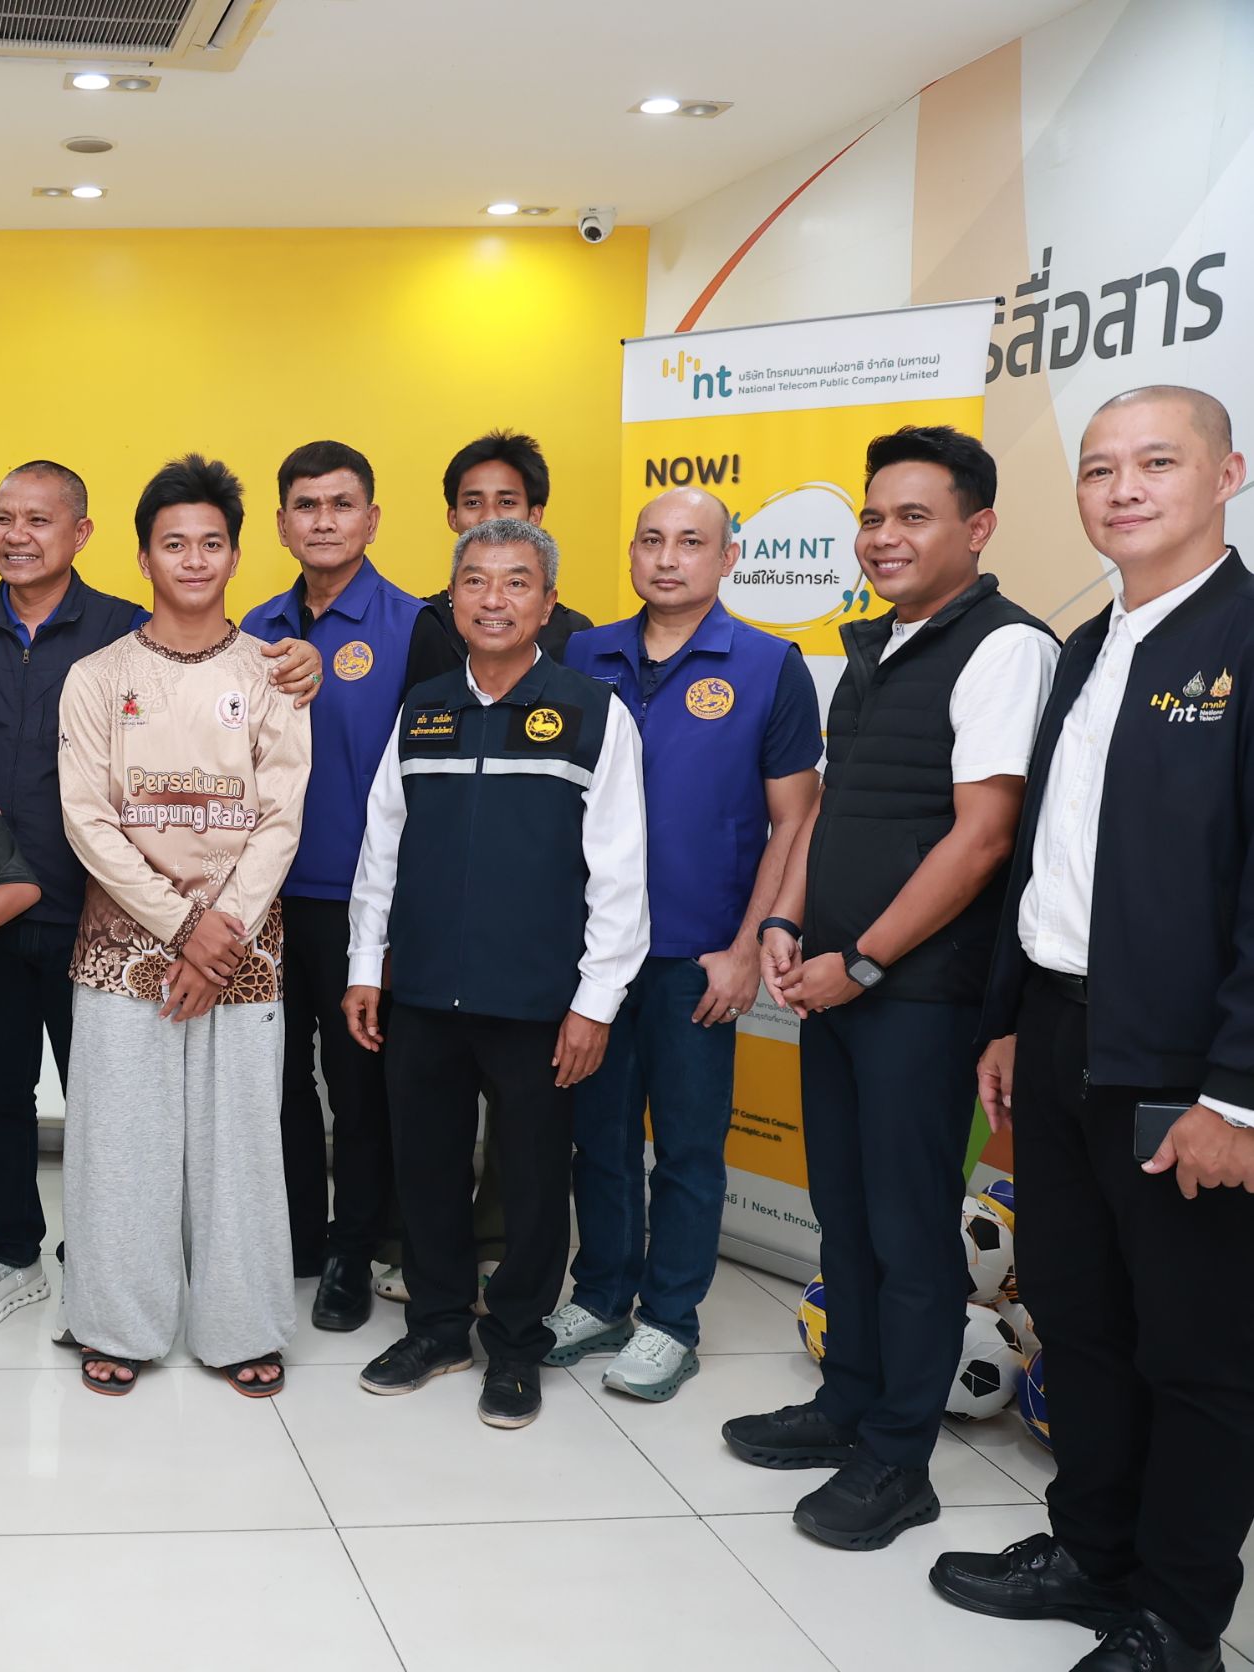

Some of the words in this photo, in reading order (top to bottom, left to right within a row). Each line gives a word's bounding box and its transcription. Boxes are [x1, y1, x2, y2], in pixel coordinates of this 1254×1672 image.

[738, 369, 764, 382] บริษัท
[867, 358, 895, 370] จำกัด
[897, 353, 941, 369] (มหาชน)
[692, 364, 733, 401] nt
[738, 383, 776, 395] National
[778, 381, 818, 392] Telecom
[820, 377, 849, 388] Public
[851, 373, 898, 386] Company
[900, 369, 940, 382] Limited
[645, 453, 741, 488] NOW!
[754, 538, 791, 560] AM
[800, 537, 835, 560] NT
[732, 569, 841, 585] ยินดีให้บริการค่ะ
[1168, 703, 1197, 722] nt
[128, 766, 244, 799] Persatuan
[752, 1201, 781, 1220] Next,
